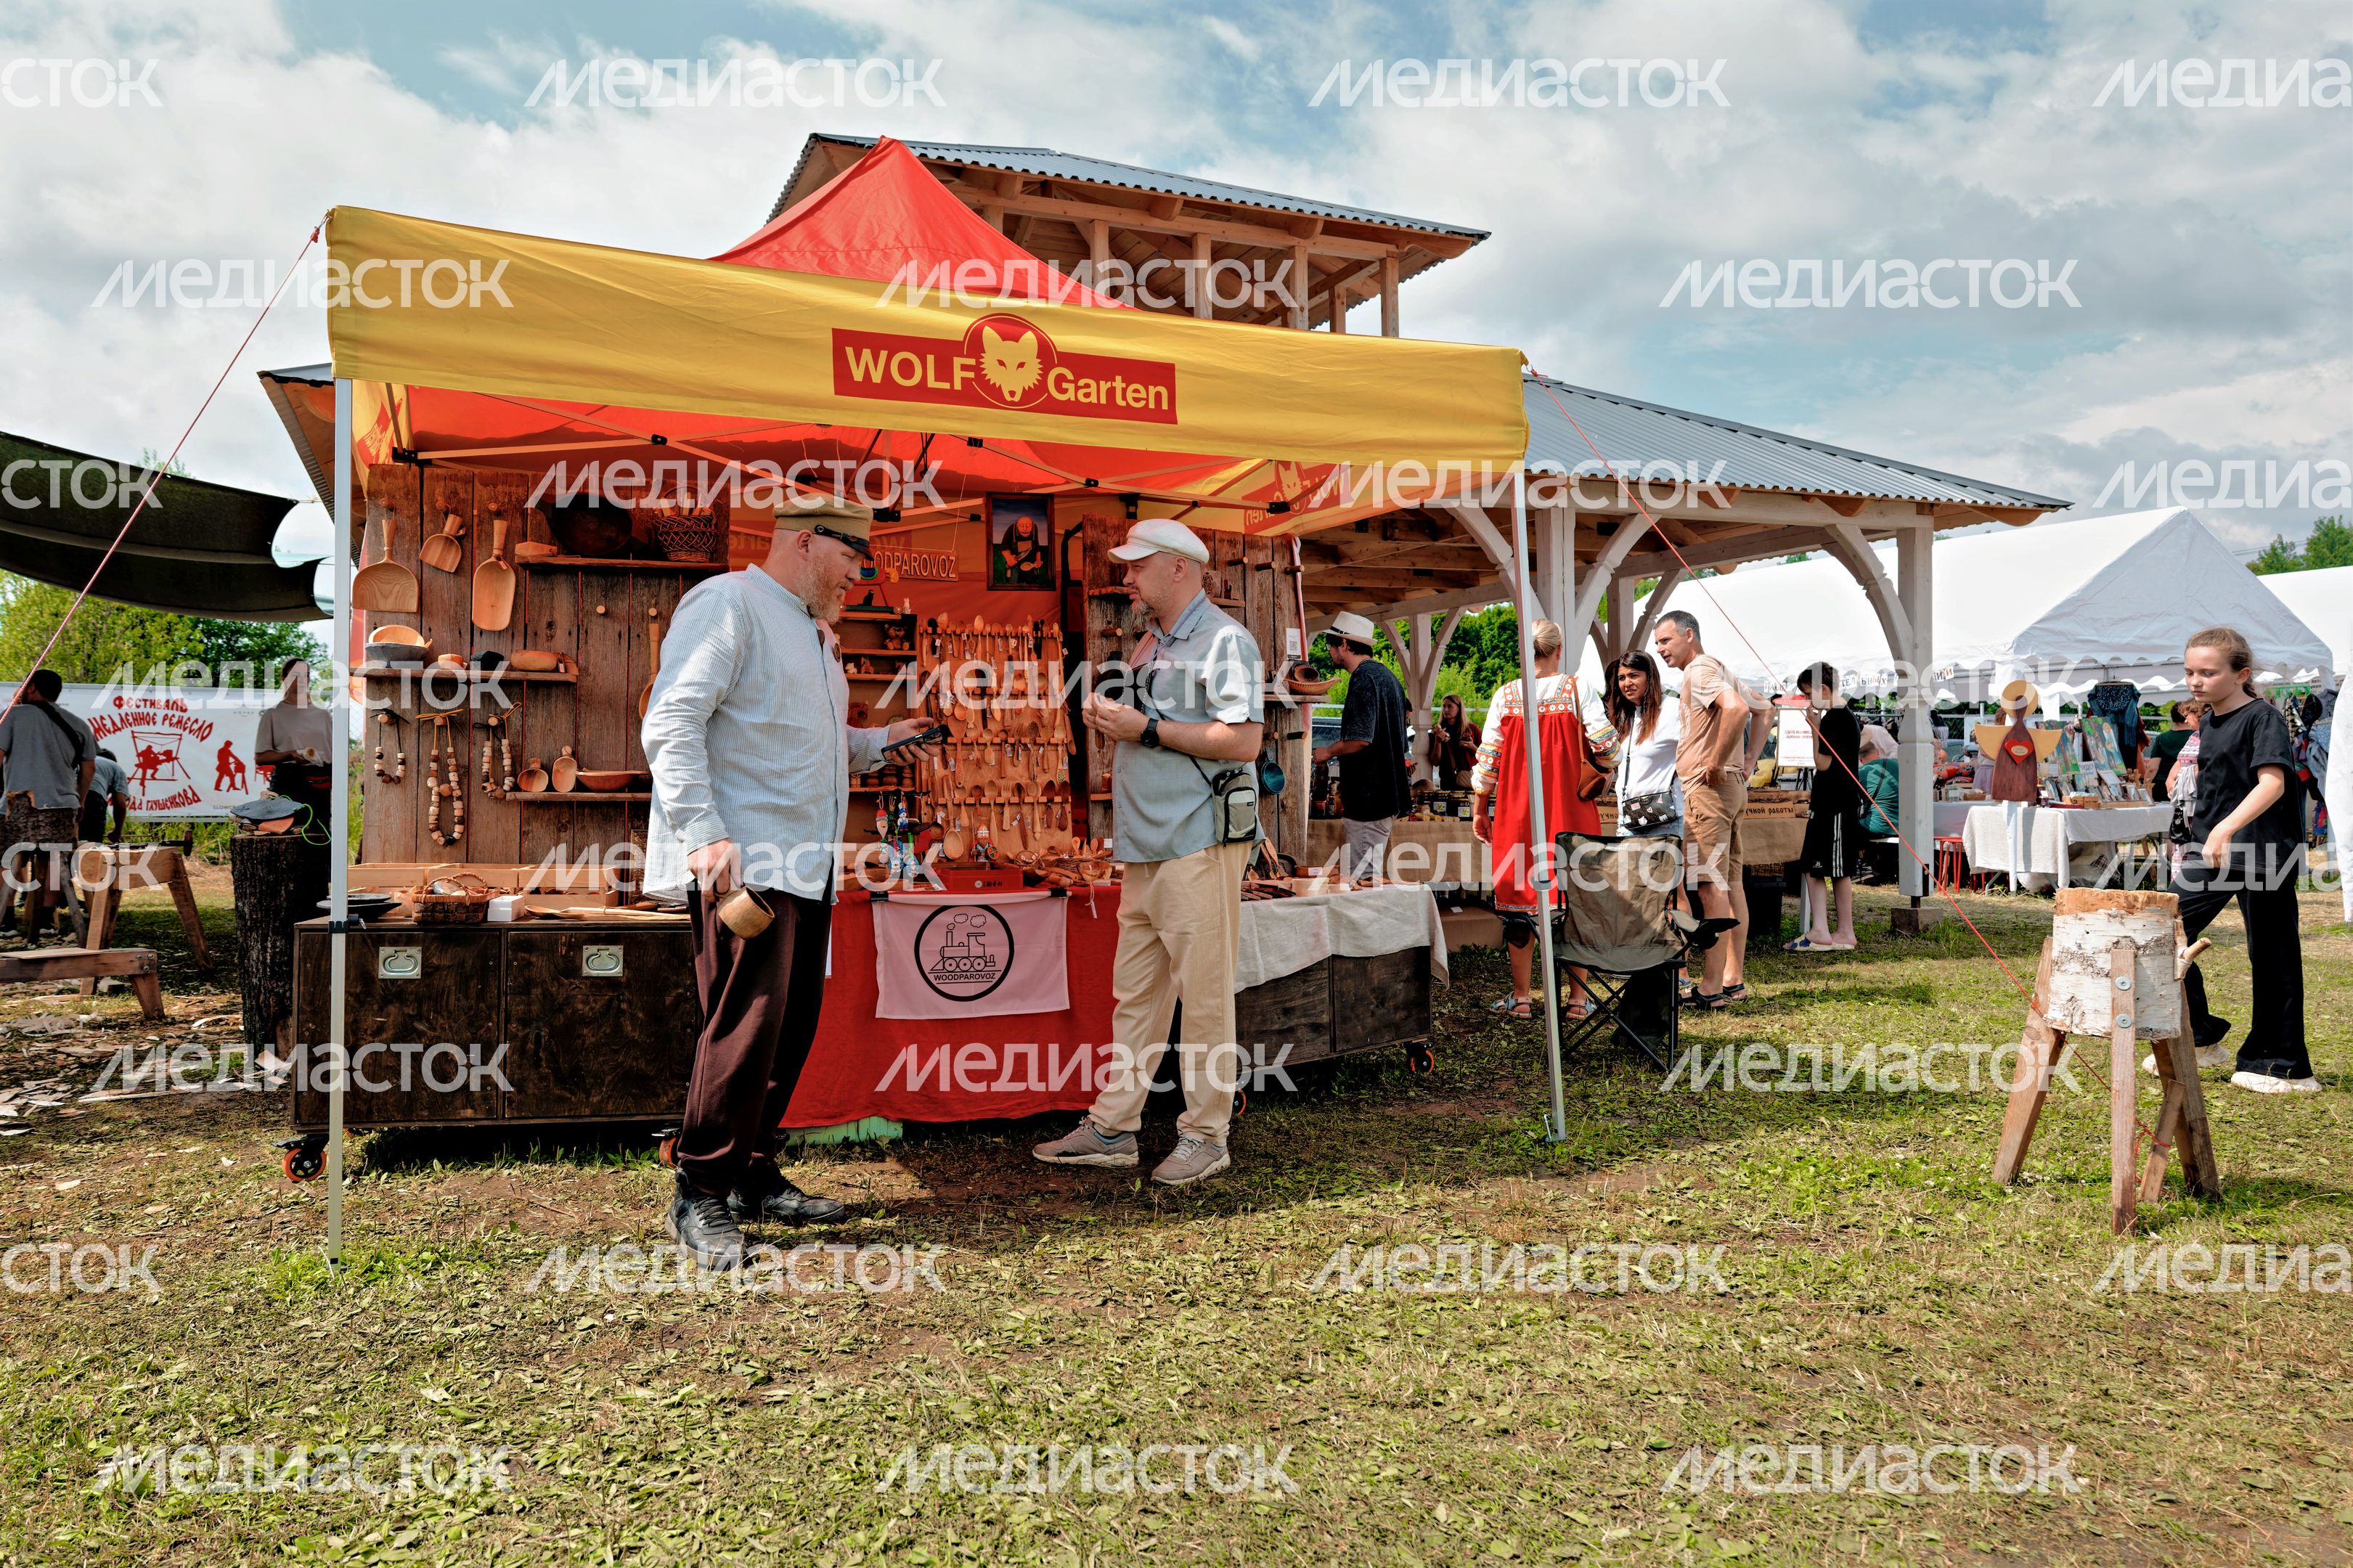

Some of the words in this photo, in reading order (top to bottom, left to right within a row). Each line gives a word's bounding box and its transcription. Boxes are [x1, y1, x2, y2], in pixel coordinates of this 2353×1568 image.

[844, 346, 978, 391] WOLF
[1047, 367, 1170, 411] Garten
[862, 550, 957, 579] ODPAROVOZ
[113, 695, 189, 714] ФЕСТИВАЛЬ
[87, 711, 158, 742] МЕДЛЕННОЕ
[161, 713, 214, 743] РЕМЕСЛО
[933, 971, 997, 983] WOODPAROVOZ
